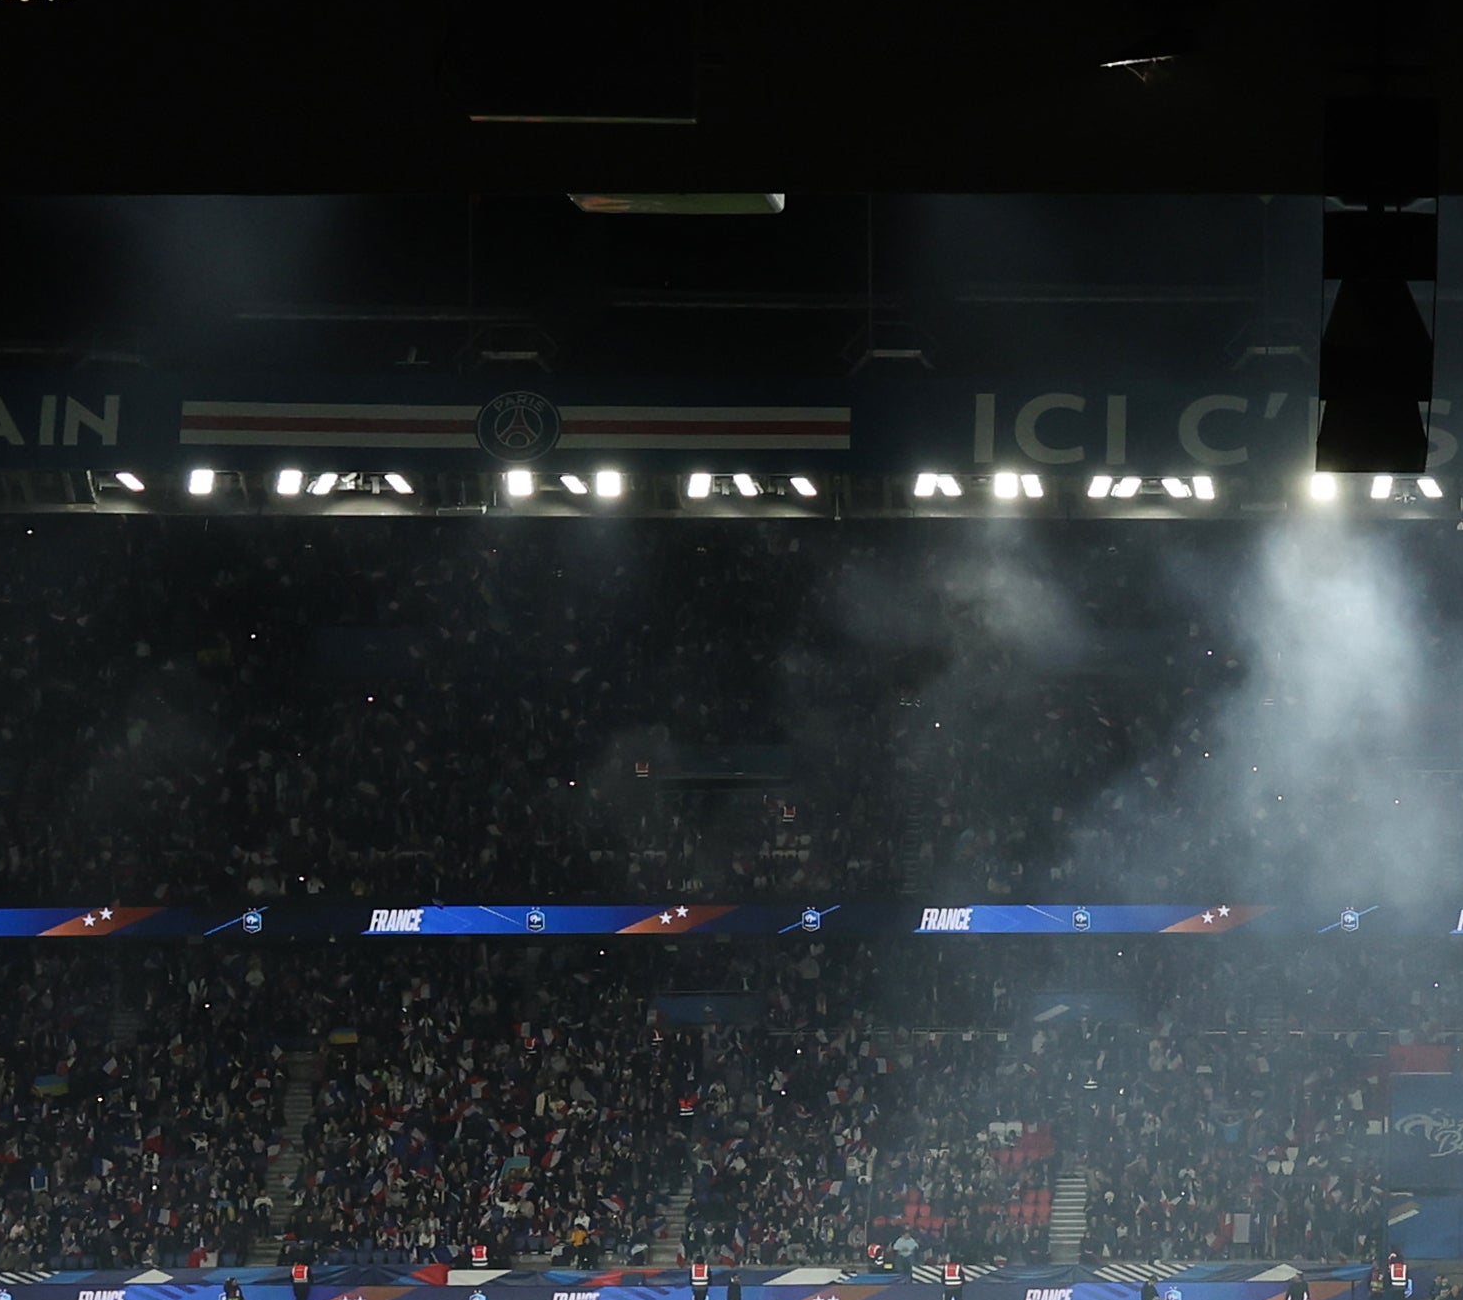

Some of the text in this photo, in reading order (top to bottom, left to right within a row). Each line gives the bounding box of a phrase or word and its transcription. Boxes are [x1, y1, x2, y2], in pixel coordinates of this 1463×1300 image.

[493, 394, 545, 412] PARIS
[977, 392, 1123, 466] ICI
[370, 909, 424, 932] FRANCE
[921, 908, 972, 930] FRANCE
